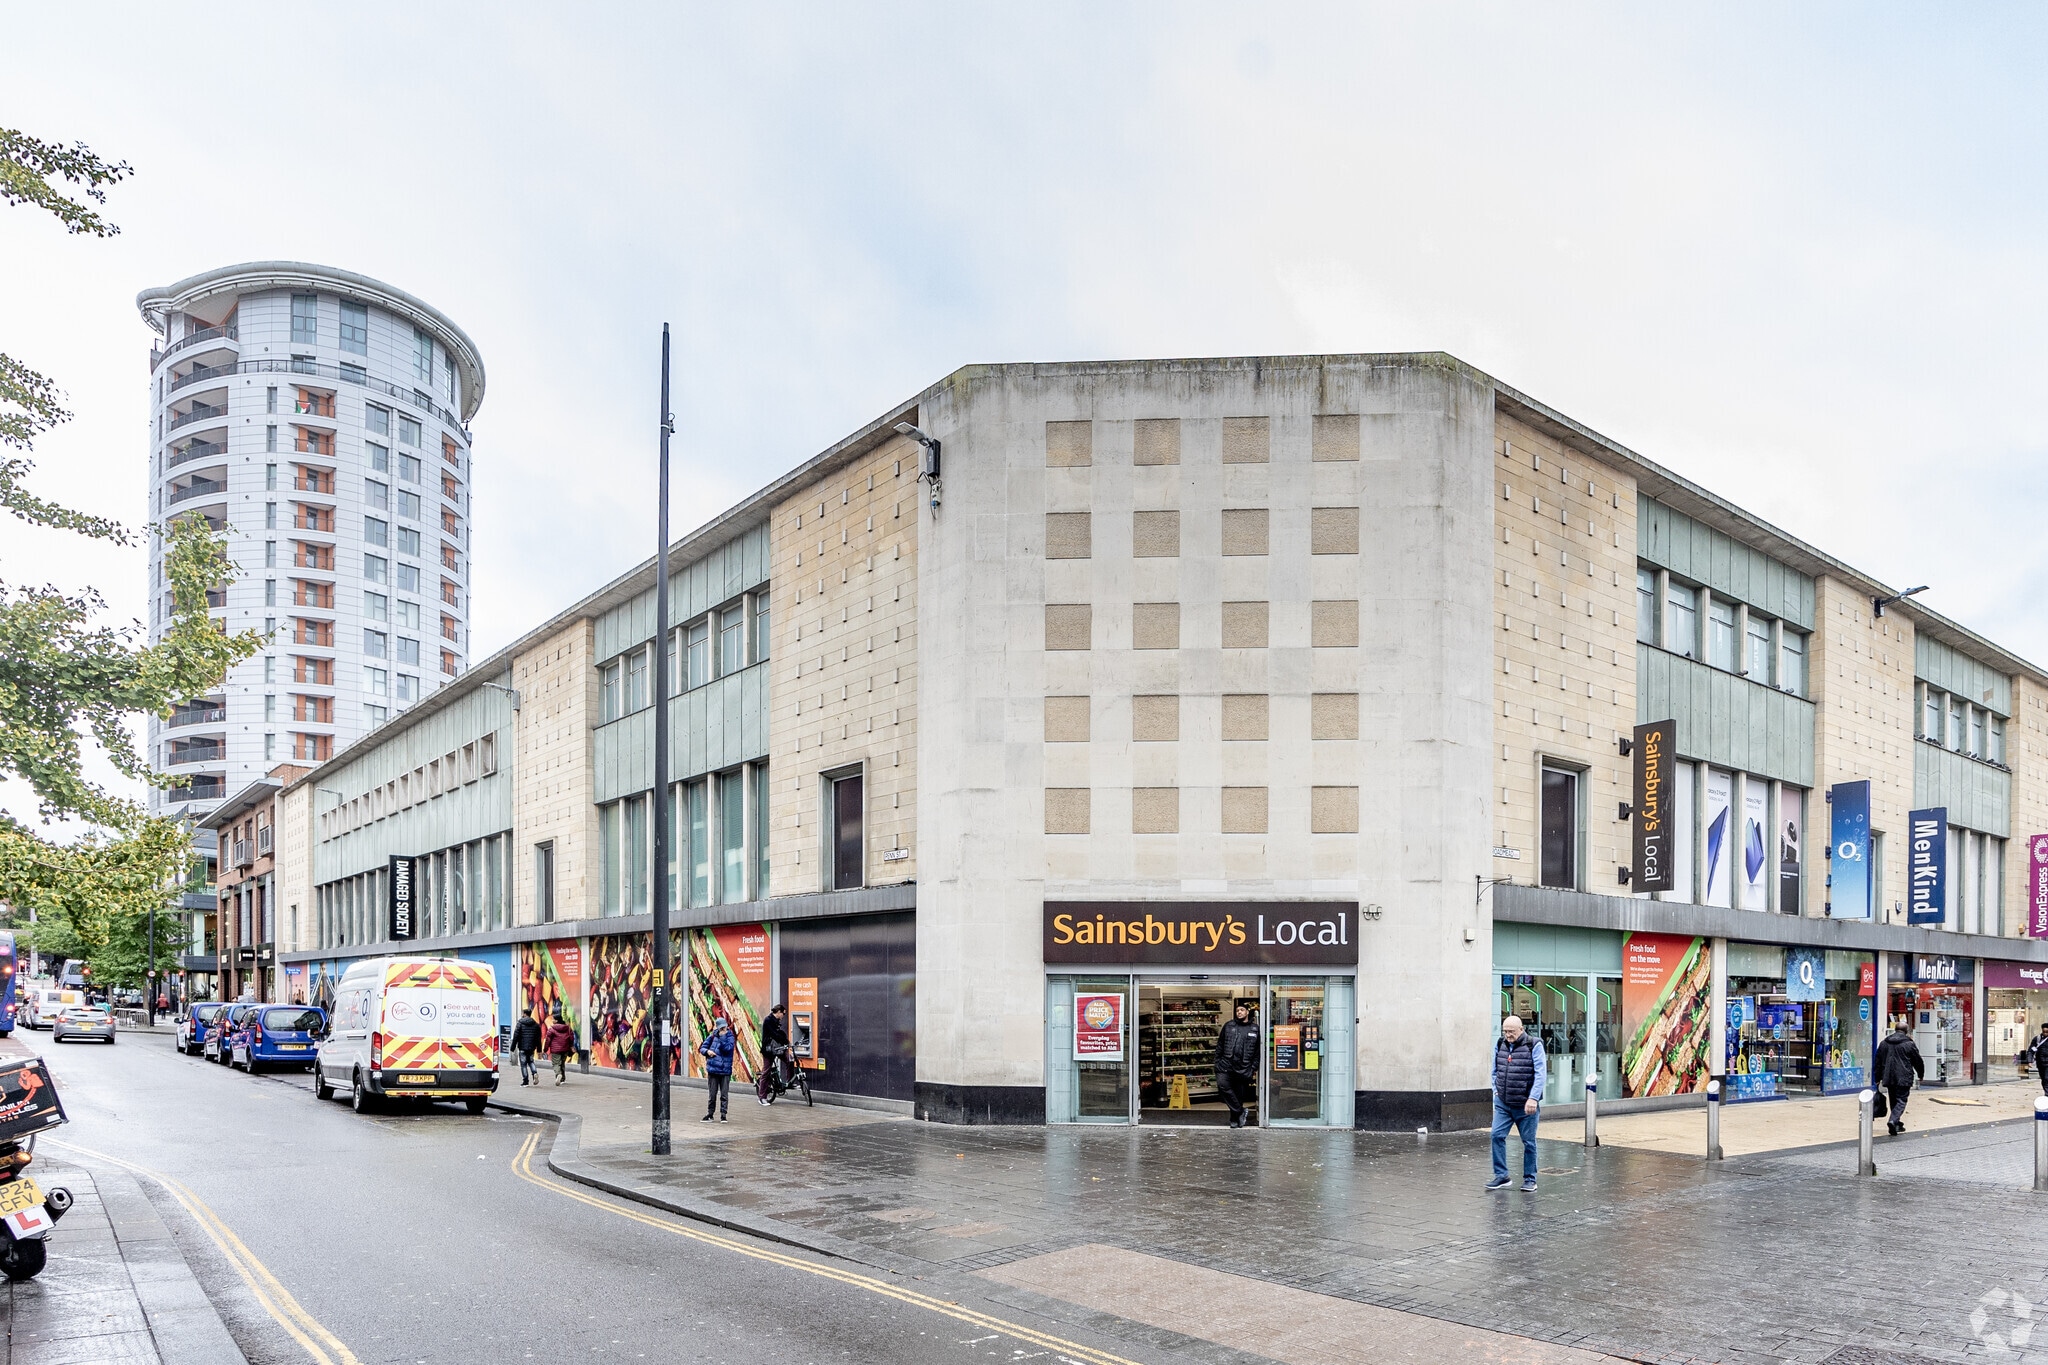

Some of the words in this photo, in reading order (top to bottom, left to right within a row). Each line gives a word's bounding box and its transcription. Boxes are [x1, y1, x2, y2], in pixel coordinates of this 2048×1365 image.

[1642, 731, 1662, 831] Sainsbury's
[1644, 835, 1661, 882] Local
[1838, 841, 1862, 862] O2
[396, 860, 409, 901] DAMAGED
[1913, 820, 1938, 914] MenKind
[396, 902, 409, 936] SOCIETY
[1053, 914, 1246, 952] Sainsbury's
[1258, 913, 1348, 946] Local
[1630, 944, 1643, 952] Fresh
[1645, 945, 1656, 953] food
[1638, 954, 1646, 962] the
[1918, 958, 1955, 981] MenKind
[0, 1192, 33, 1212] CFV
[14, 1211, 42, 1231] L
